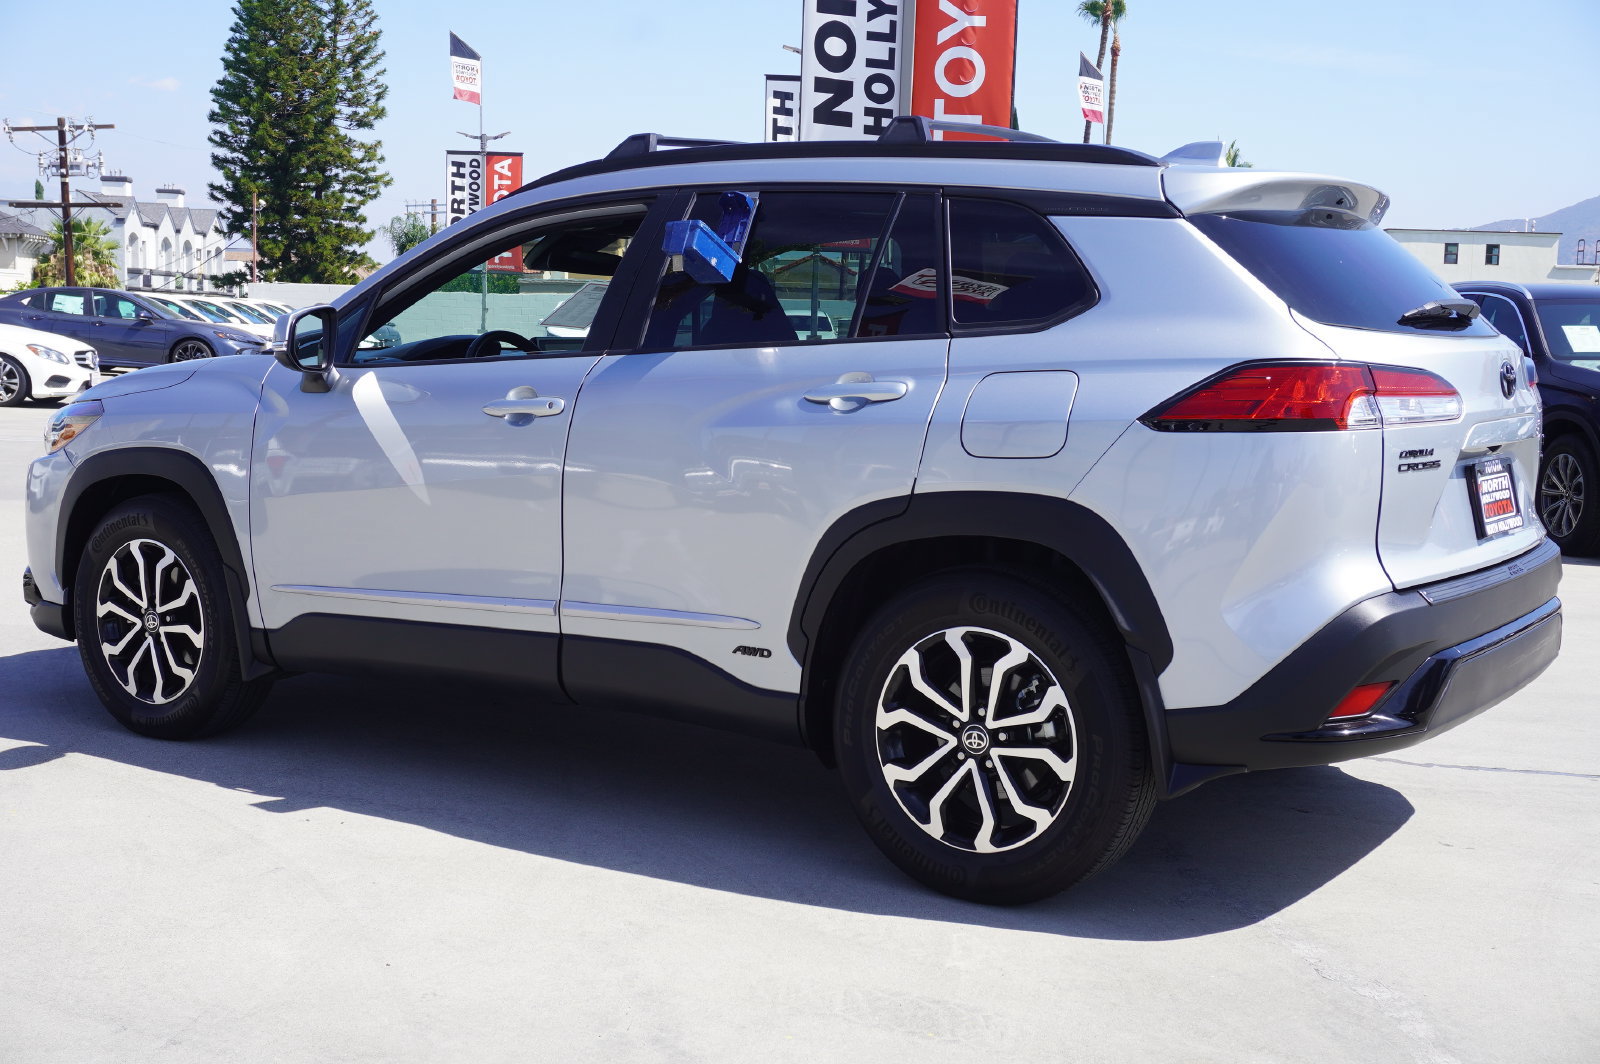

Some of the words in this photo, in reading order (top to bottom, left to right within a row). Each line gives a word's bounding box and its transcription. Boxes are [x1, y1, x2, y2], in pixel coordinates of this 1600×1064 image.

[933, 0, 986, 141] TOY
[772, 90, 793, 141] TH
[1398, 460, 1441, 472] CROSS
[1482, 476, 1509, 493] NORTH
[1482, 490, 1510, 504] HOLLYWOOD
[1484, 500, 1514, 518] TOYOTA
[92, 513, 141, 553] Continental
[969, 592, 1068, 664] Continental
[732, 645, 772, 658] AWD
